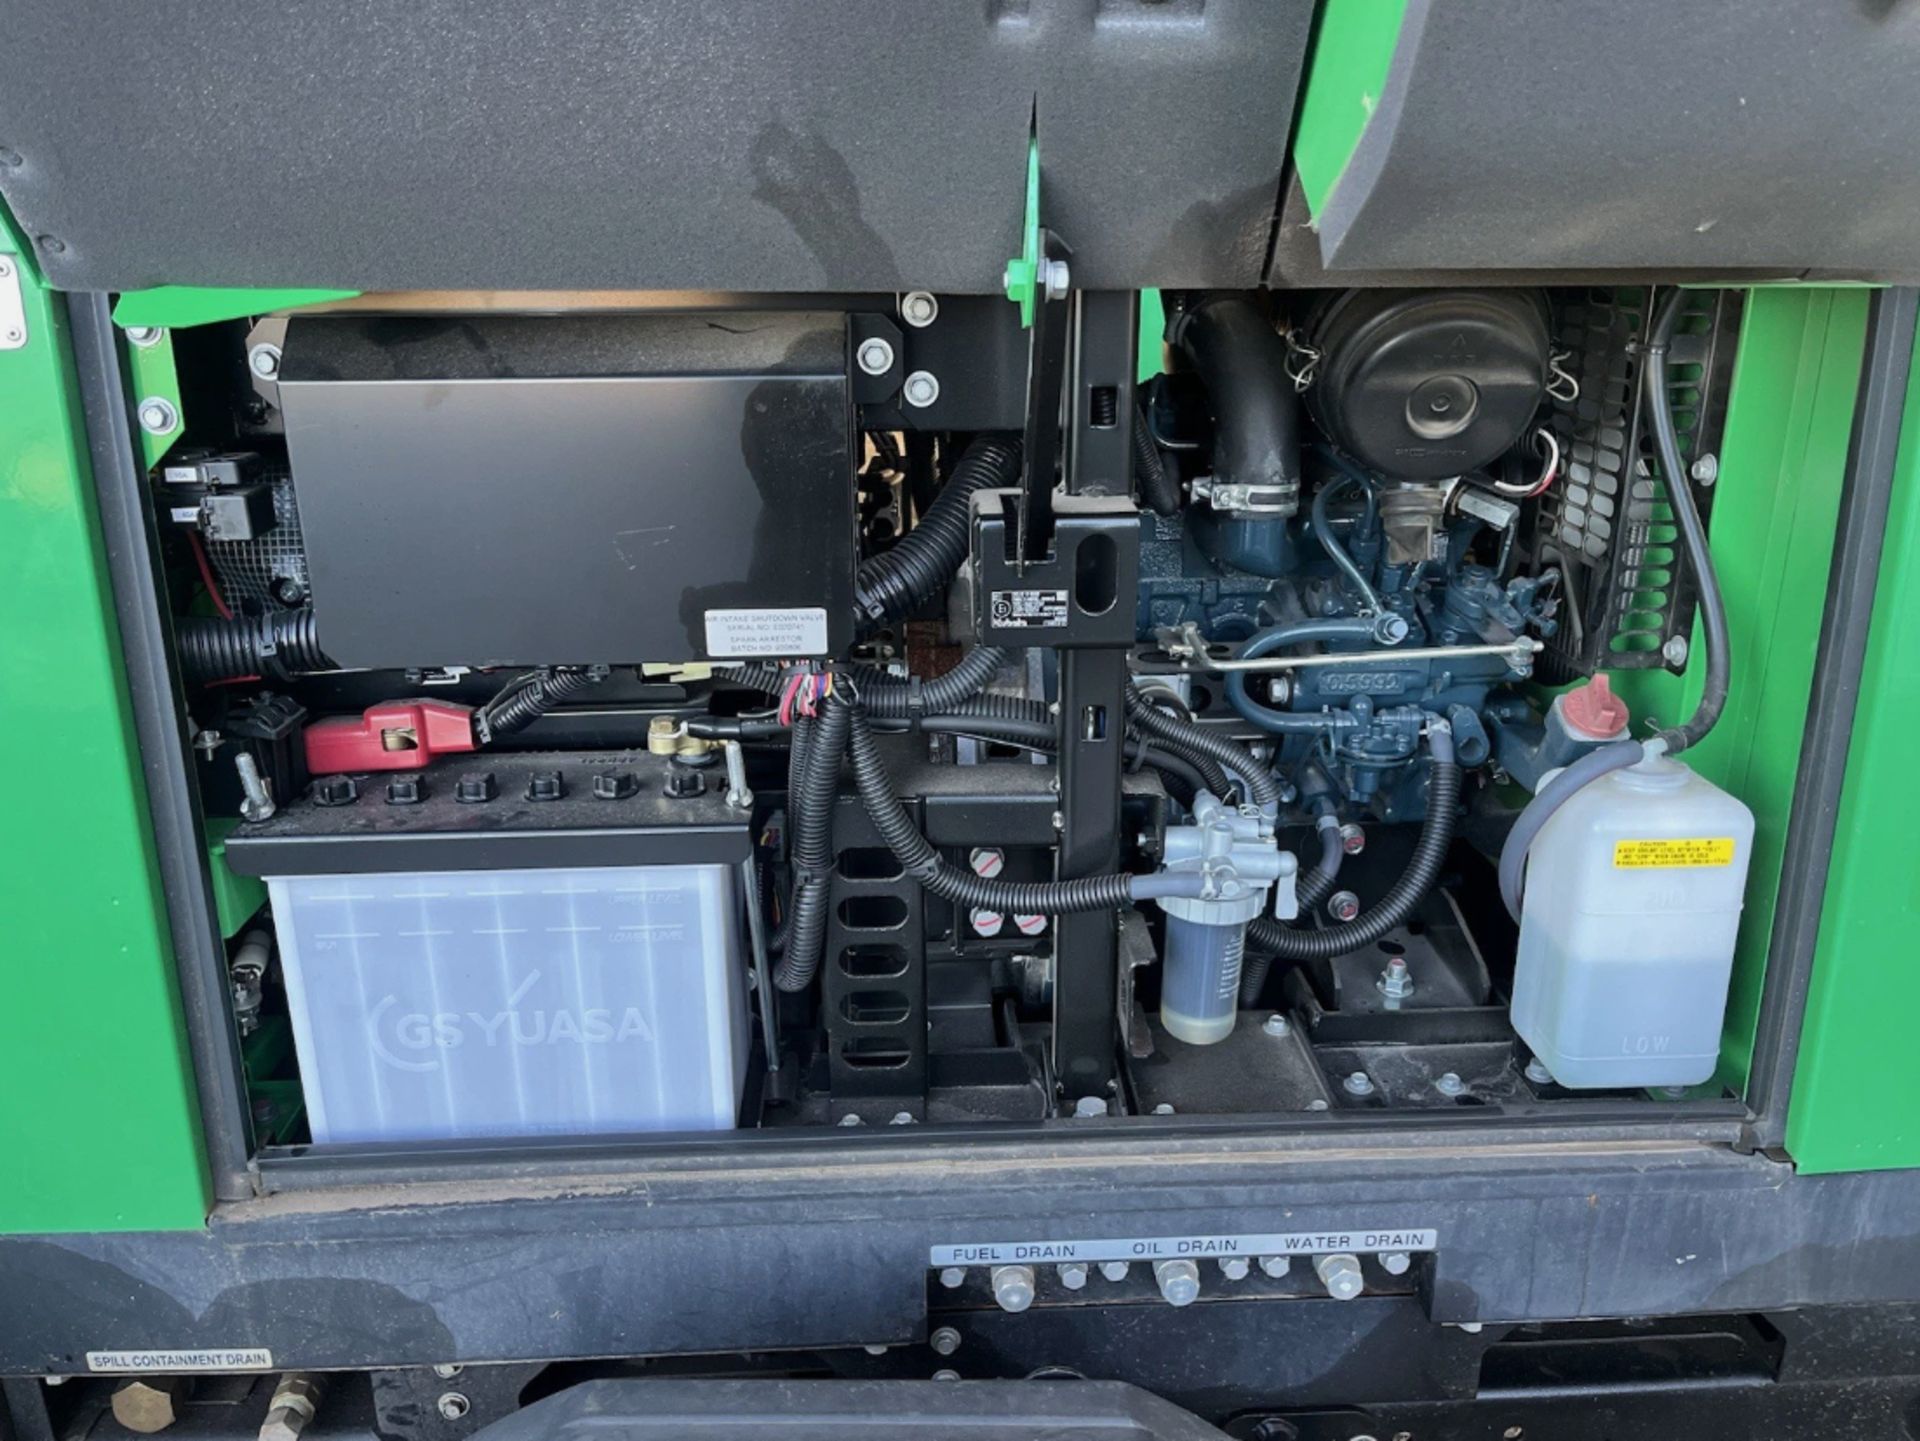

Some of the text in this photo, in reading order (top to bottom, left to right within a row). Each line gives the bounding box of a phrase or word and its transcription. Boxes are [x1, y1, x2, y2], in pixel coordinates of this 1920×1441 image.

[759, 634, 803, 642] ARRESTOR
[1622, 1036, 1670, 1054] LOW
[1132, 1239, 1238, 1255] OIL DRAIN
[1285, 1233, 1425, 1250] WATER DRAIN
[952, 1245, 1076, 1261] FUEL DRAIN
[94, 1353, 266, 1368] SPILL CONTAINMENT DRAIN
